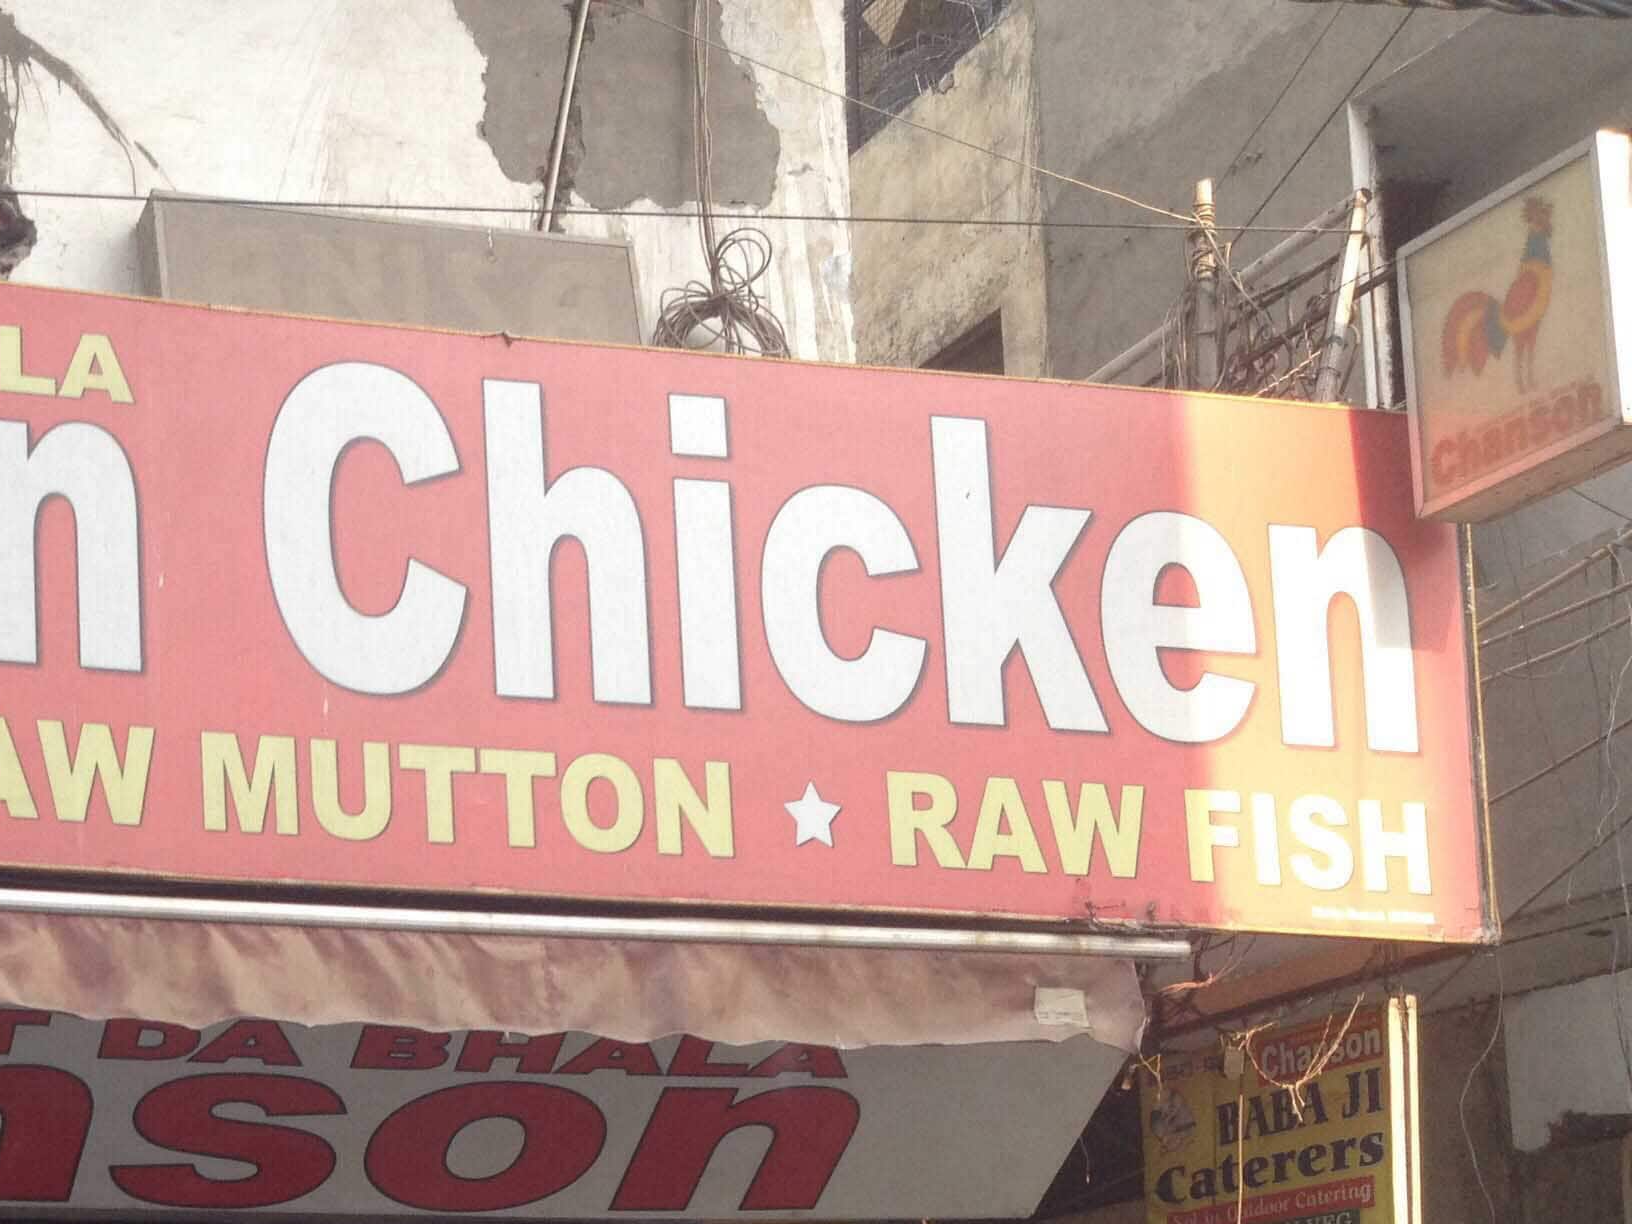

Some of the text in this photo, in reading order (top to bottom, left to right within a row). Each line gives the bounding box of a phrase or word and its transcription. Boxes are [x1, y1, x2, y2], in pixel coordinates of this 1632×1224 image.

[262, 360, 1421, 754] Chicken
[199, 730, 736, 858] MUTTON
[886, 770, 1146, 880] RAW
[1184, 787, 1434, 896] FISH
[97, 1018, 302, 1068] DA
[350, 1025, 850, 1079] BHALA
[1342, 1068, 1383, 1119] JI
[1154, 1131, 1384, 1203] Caterers
[1295, 1181, 1373, 1209] Catering
